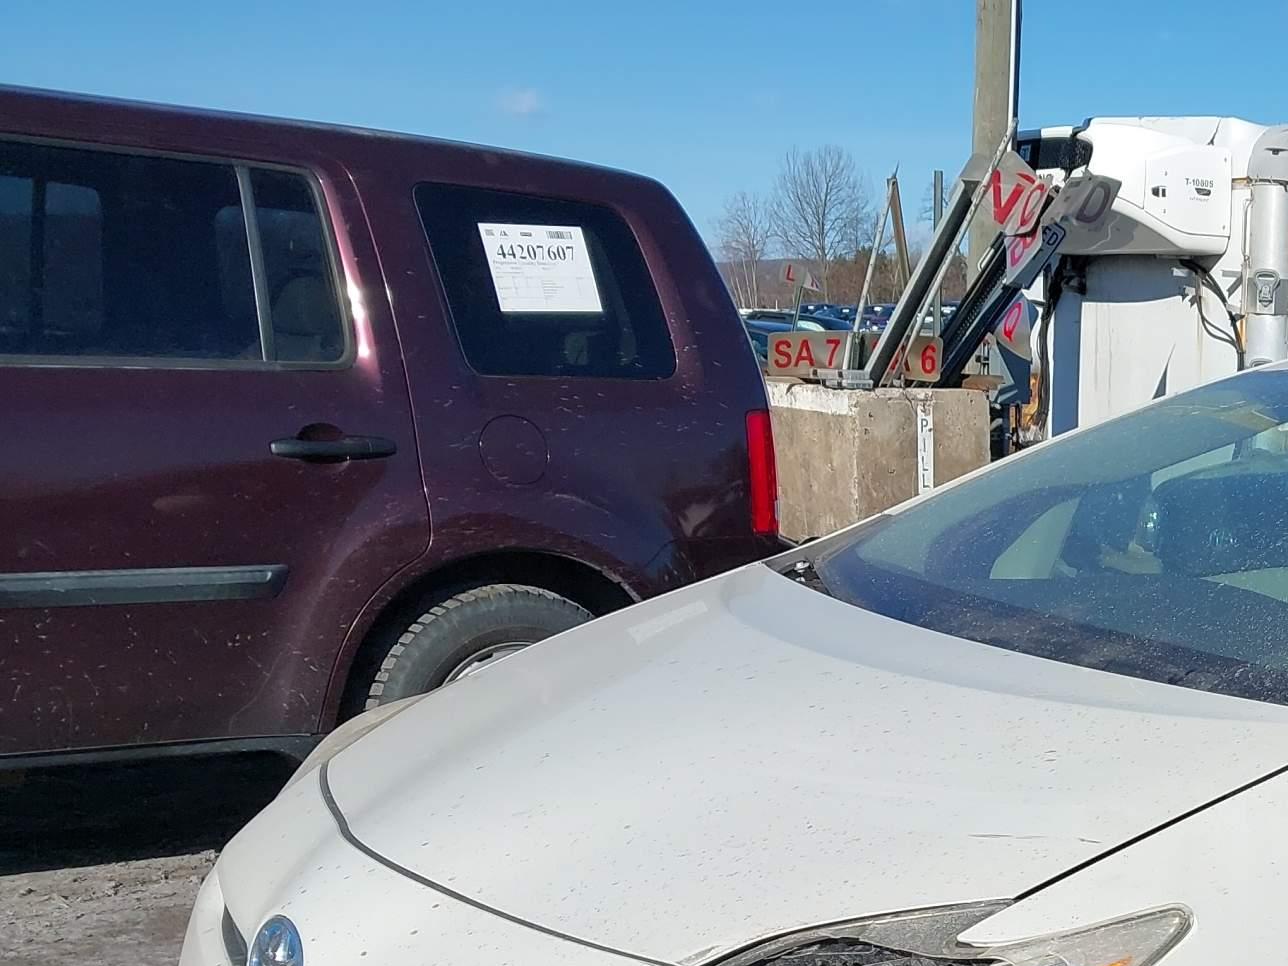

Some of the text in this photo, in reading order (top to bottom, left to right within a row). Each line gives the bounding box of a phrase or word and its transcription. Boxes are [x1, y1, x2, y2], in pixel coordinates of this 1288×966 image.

[496, 243, 574, 261] 44207607
[773, 338, 842, 369] SA 7
[920, 343, 937, 375] 6
